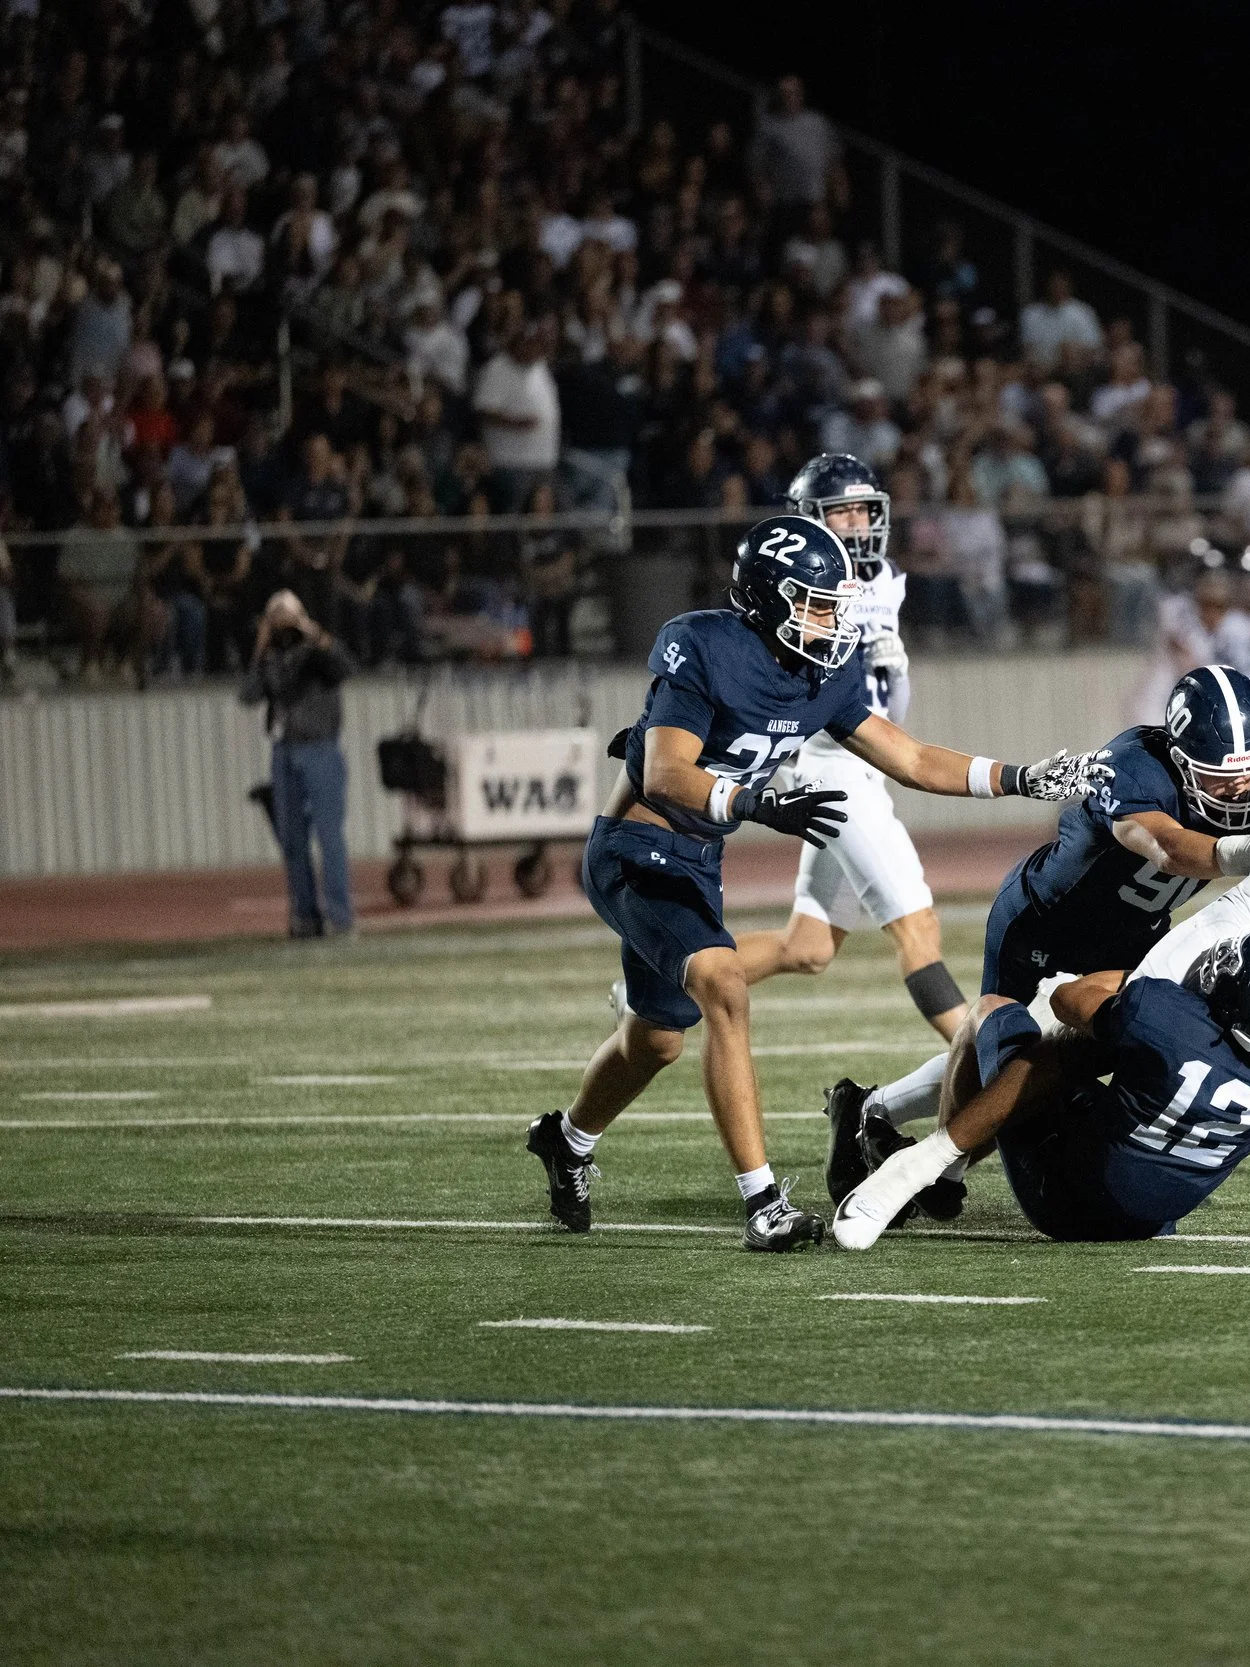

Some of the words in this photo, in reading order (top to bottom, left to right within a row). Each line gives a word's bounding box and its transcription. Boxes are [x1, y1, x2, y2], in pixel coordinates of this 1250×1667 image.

[758, 527, 807, 567] 22
[663, 641, 688, 675] SV
[766, 719, 800, 734] RANGERS
